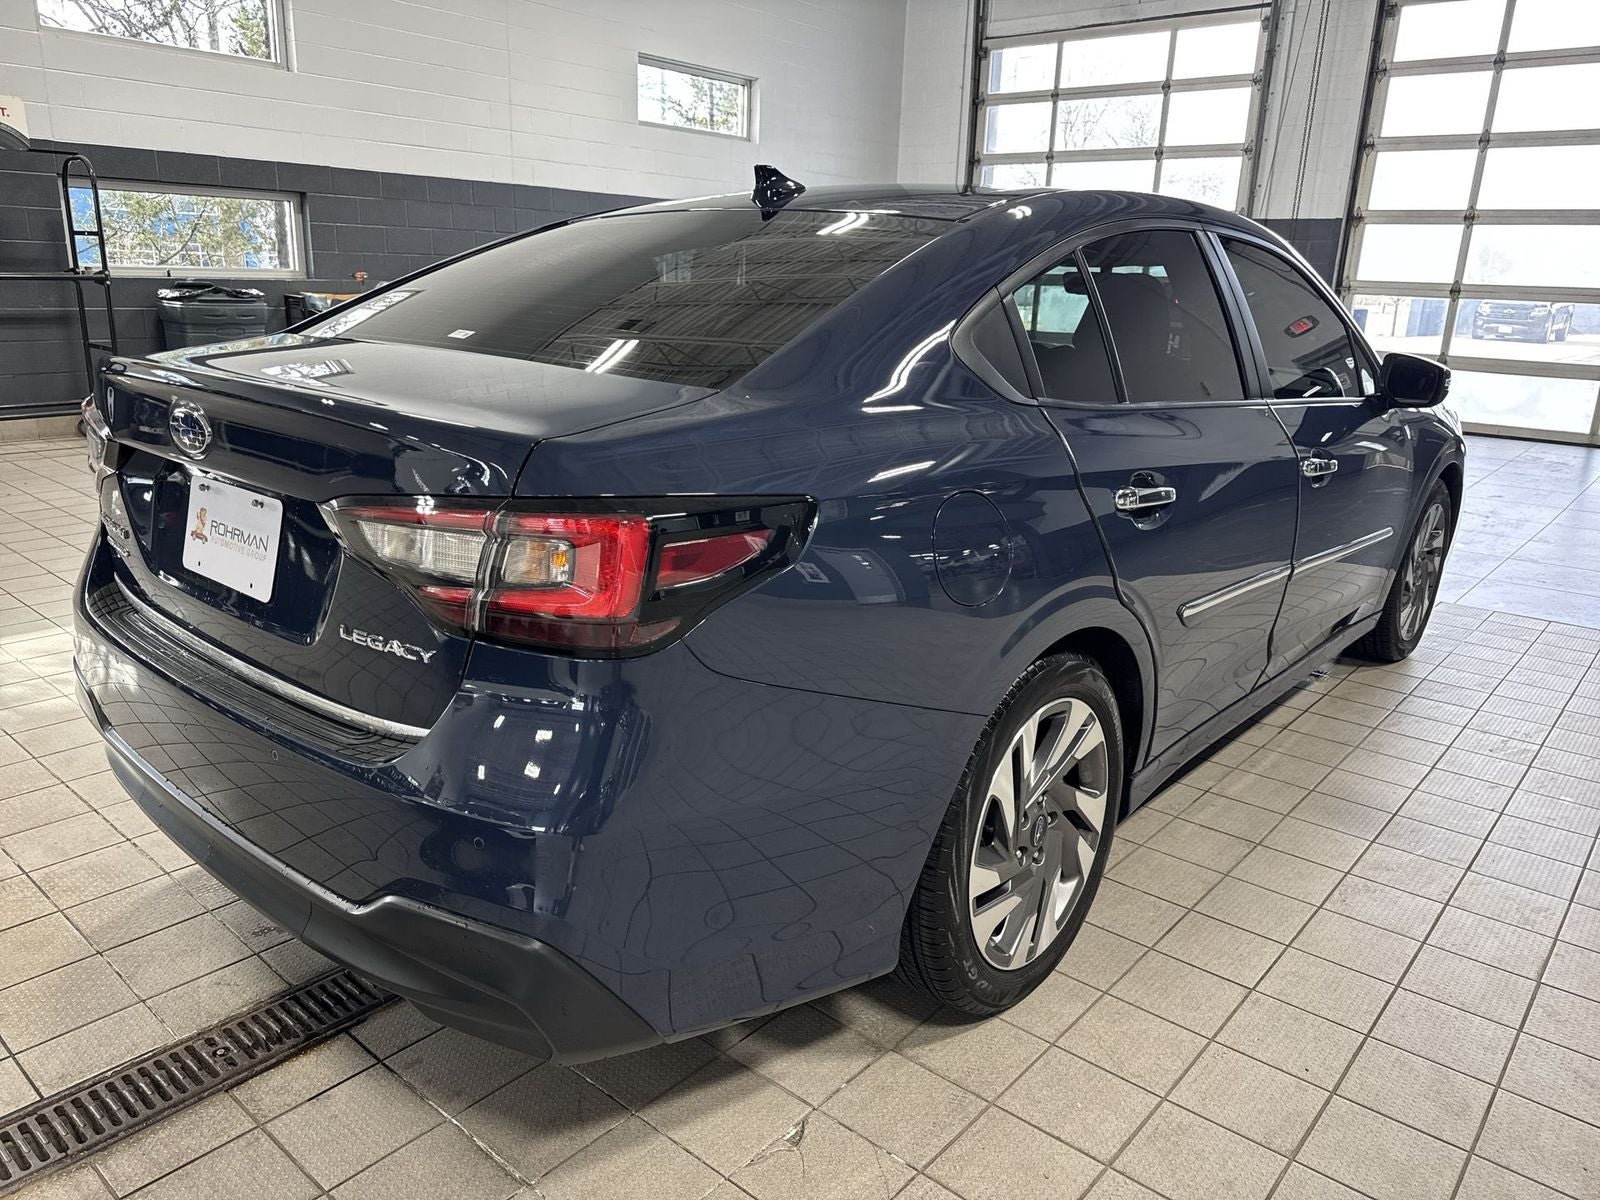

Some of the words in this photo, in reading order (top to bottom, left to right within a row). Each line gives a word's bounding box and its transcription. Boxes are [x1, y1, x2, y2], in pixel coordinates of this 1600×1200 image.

[209, 519, 270, 553] ROHRMAN
[246, 547, 268, 562] GROUP
[339, 623, 437, 664] LEGACY
